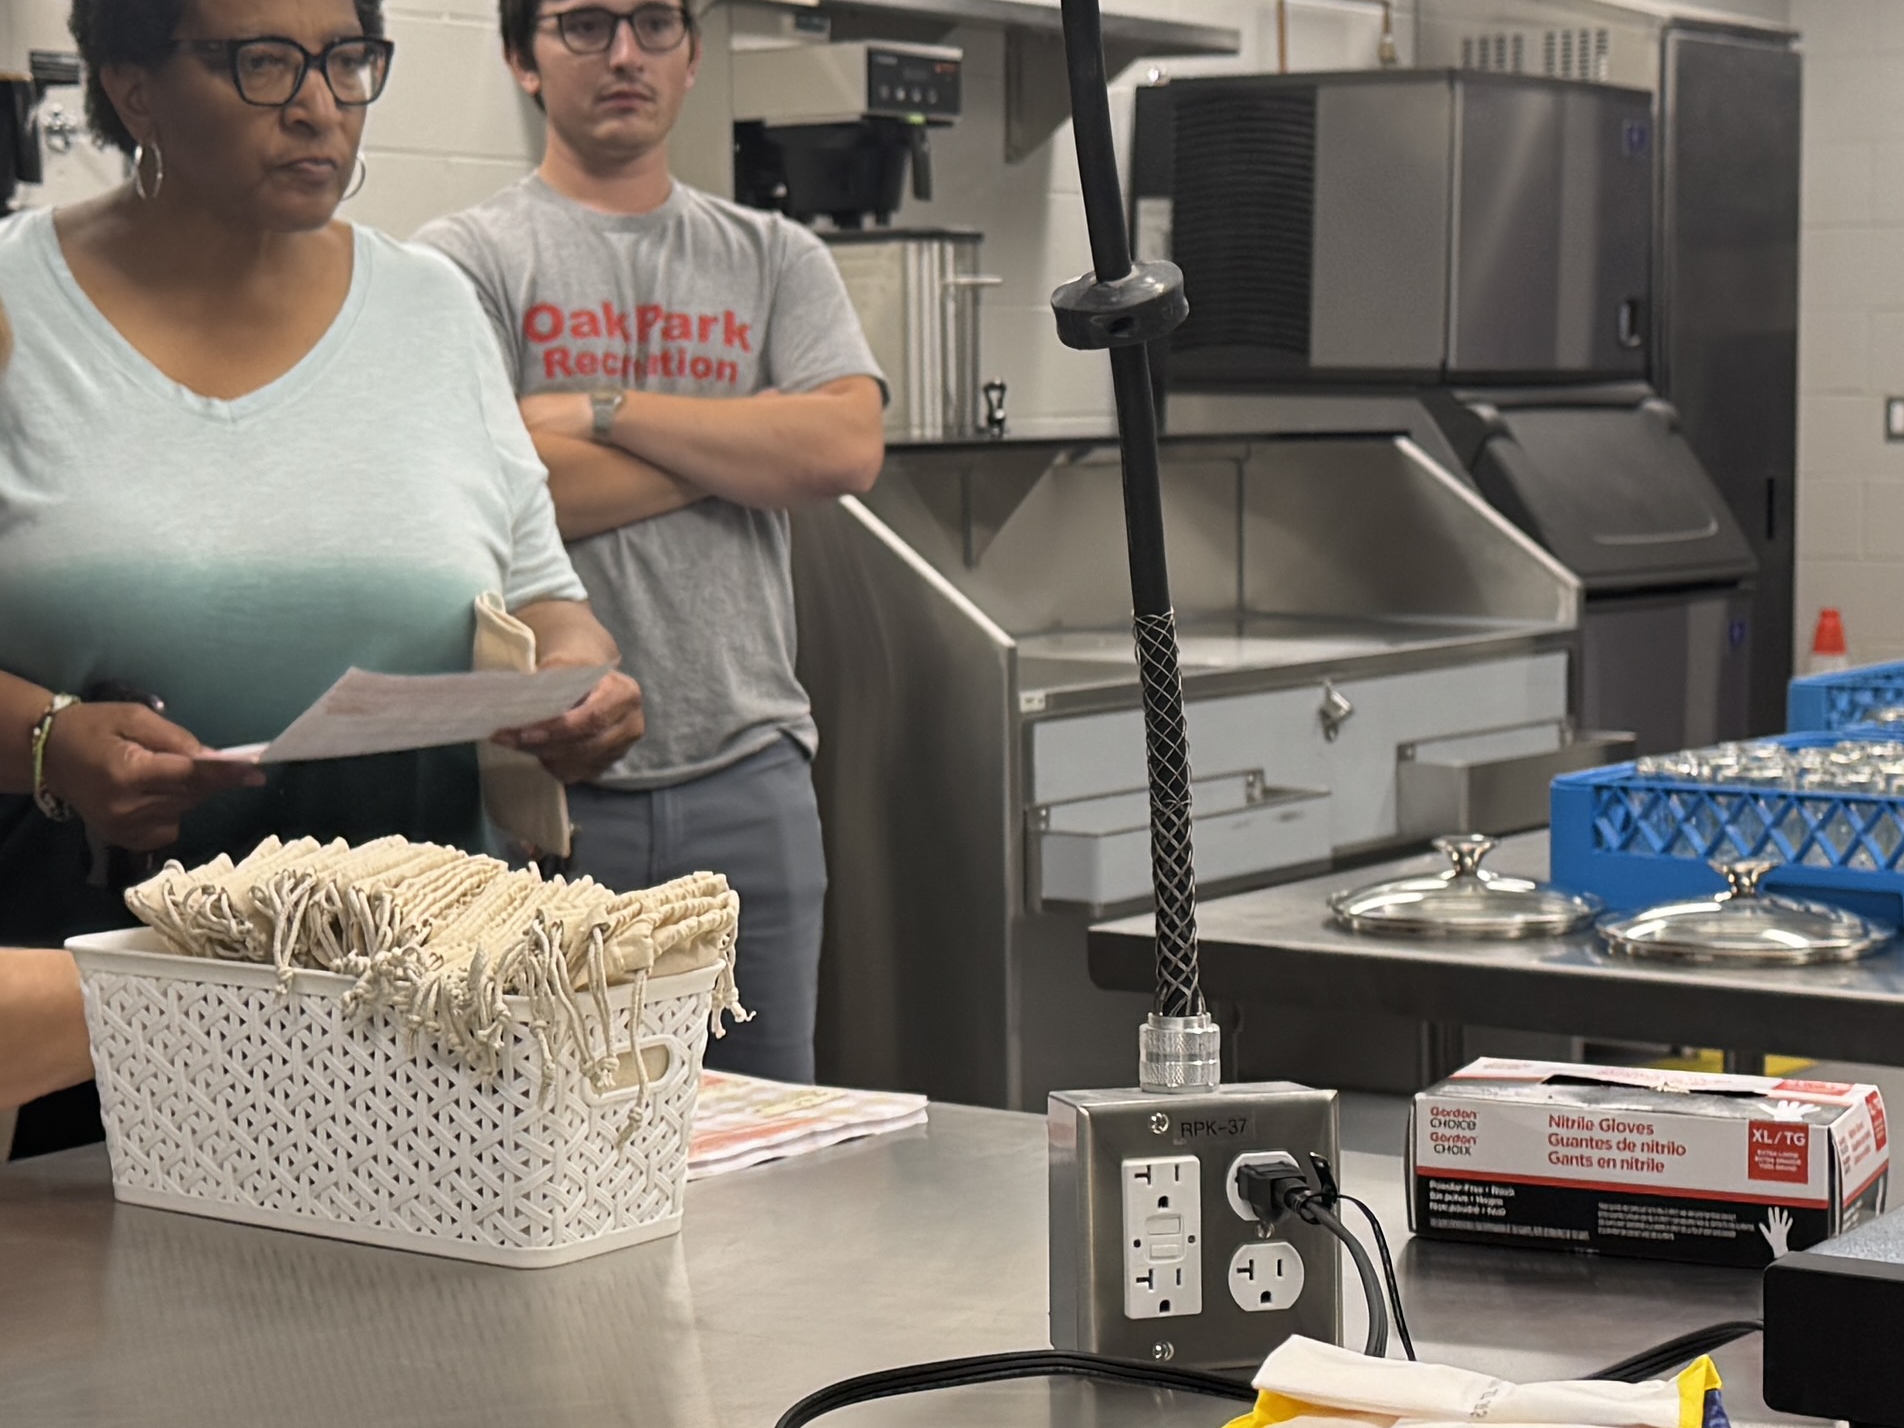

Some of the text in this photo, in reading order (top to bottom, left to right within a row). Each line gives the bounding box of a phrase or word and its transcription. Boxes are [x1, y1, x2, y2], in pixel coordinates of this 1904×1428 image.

[523, 300, 751, 353] Oak Park
[1430, 1106, 1477, 1120] Gordon
[1180, 1119, 1247, 1138] RPK-37
[1548, 1113, 1654, 1136] Nitrile Gloves
[1429, 1131, 1477, 1146] Gordon
[1548, 1132, 1687, 1157] Guantes de nitrilo
[1548, 1151, 1665, 1173] Gants en nitrile
